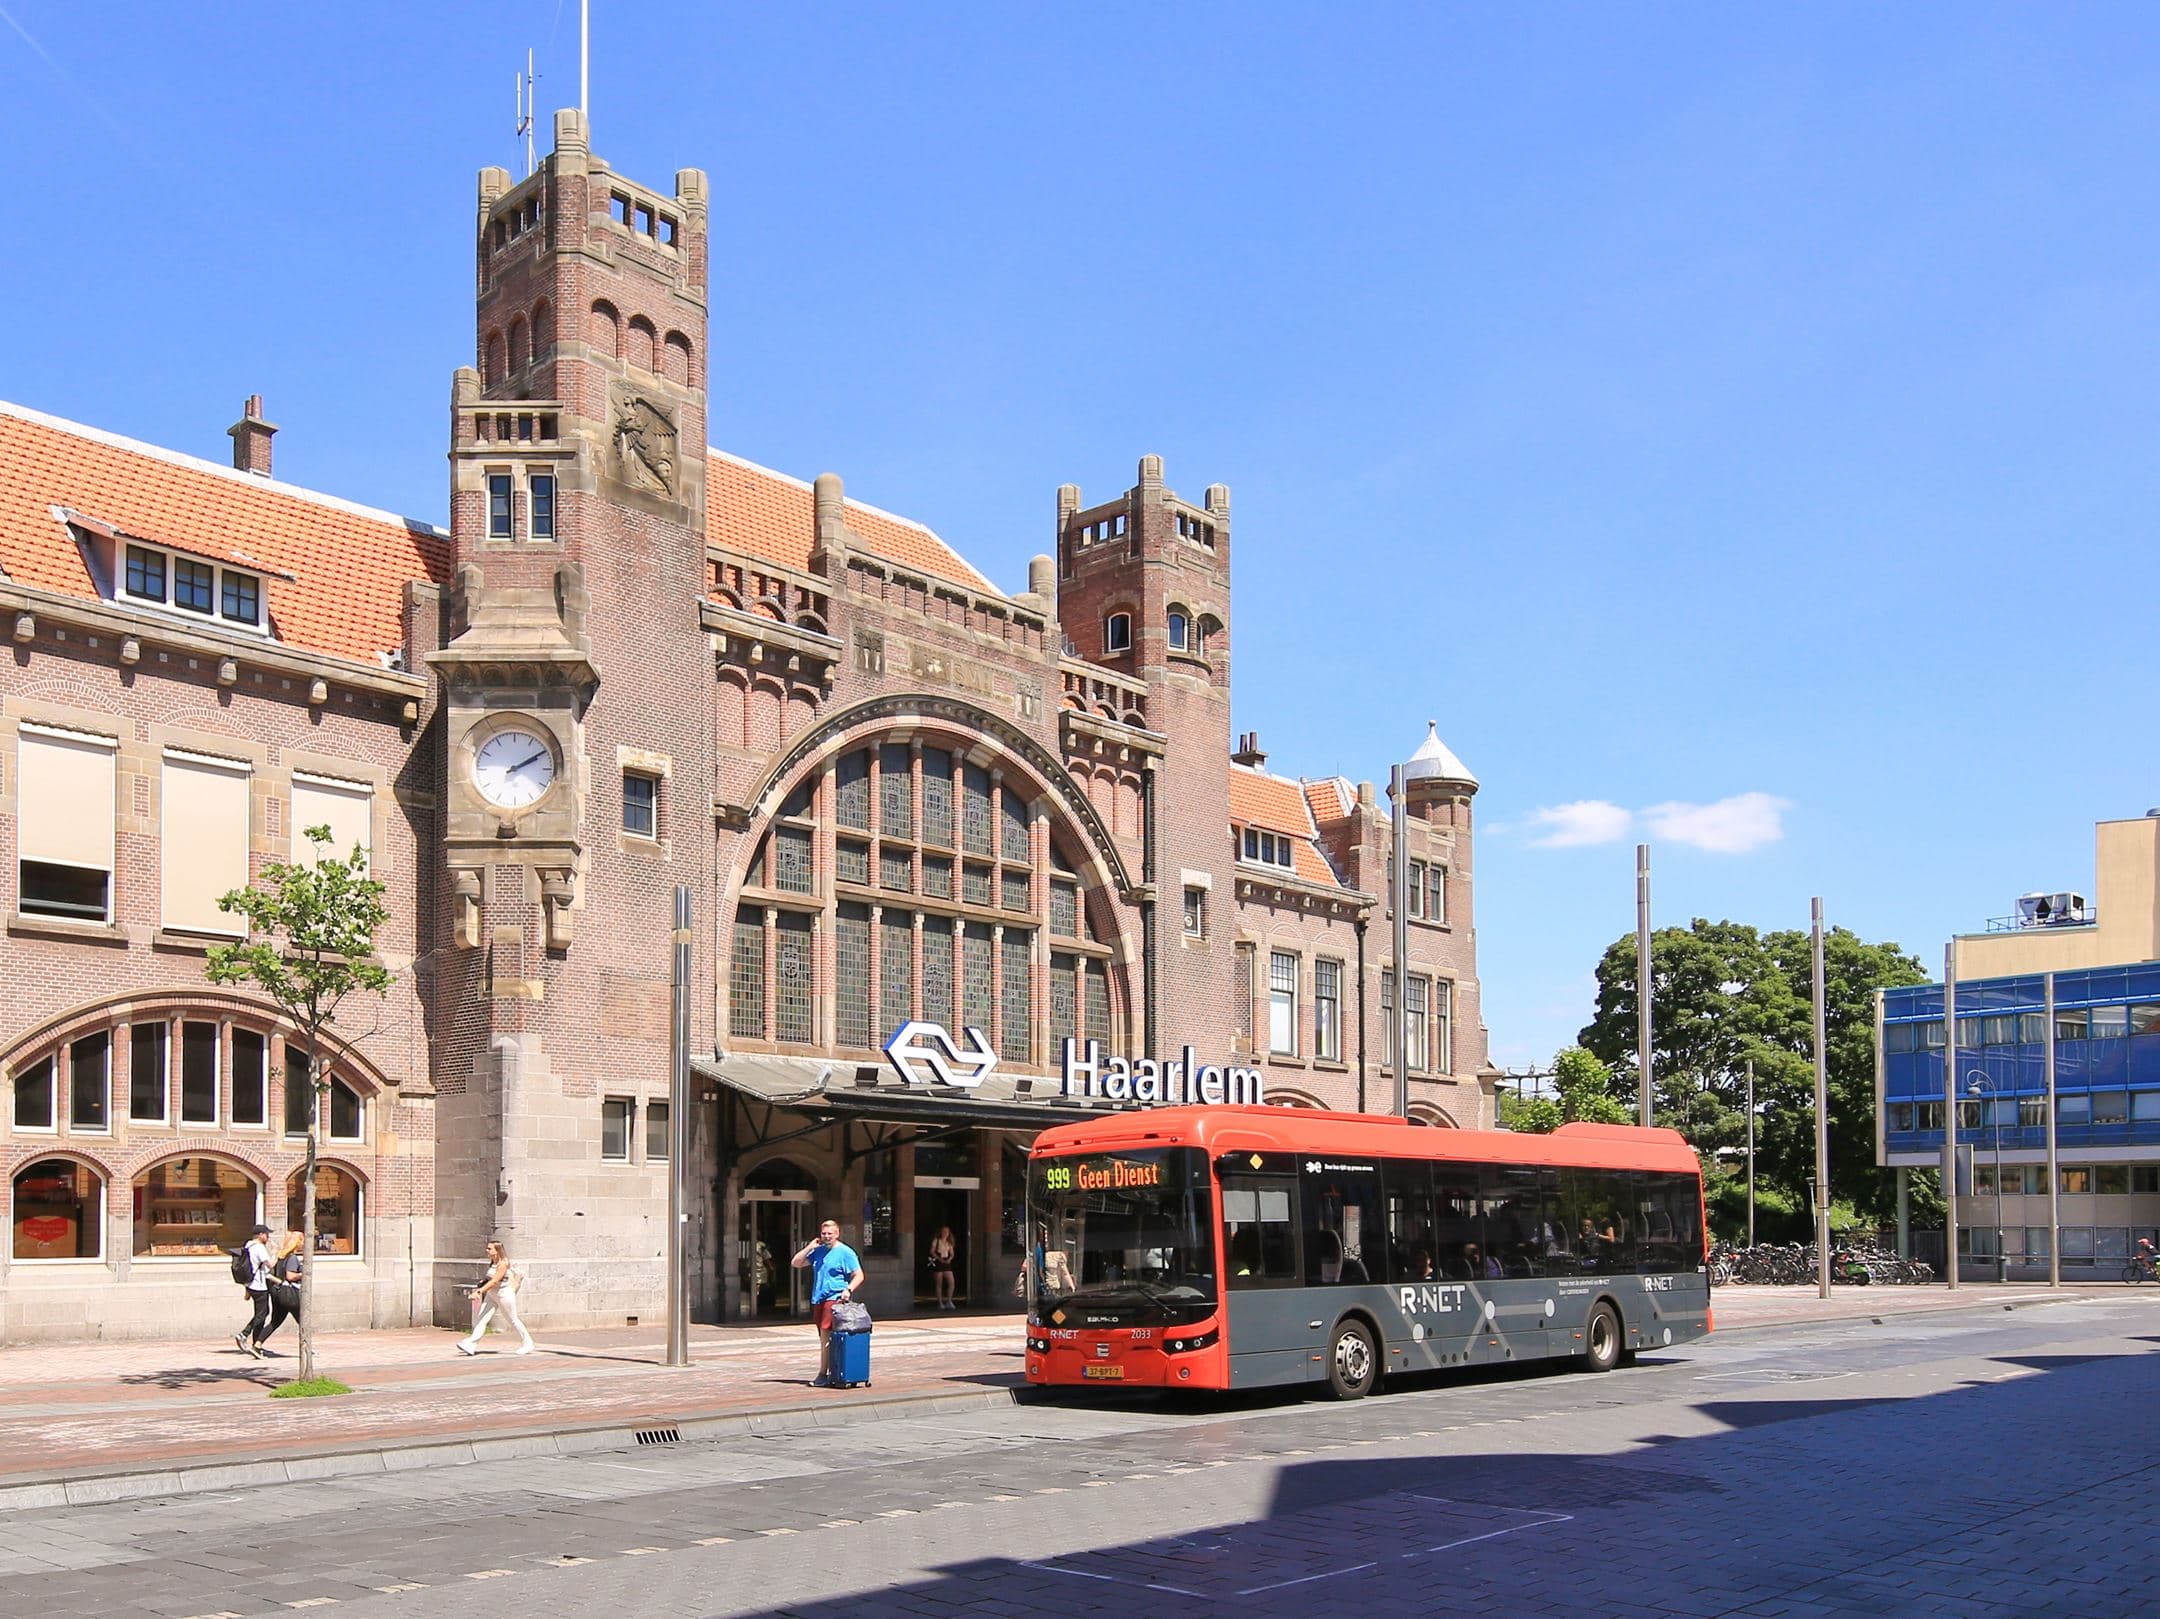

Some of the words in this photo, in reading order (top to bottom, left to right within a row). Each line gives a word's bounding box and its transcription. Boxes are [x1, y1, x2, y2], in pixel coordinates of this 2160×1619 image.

[1062, 1037, 1264, 1105] Haarlem
[1047, 1167, 1070, 1189] 999
[1078, 1164, 1111, 1190] Geen
[1114, 1160, 1158, 1187] Dienst
[1130, 1329, 1152, 1340] 2033
